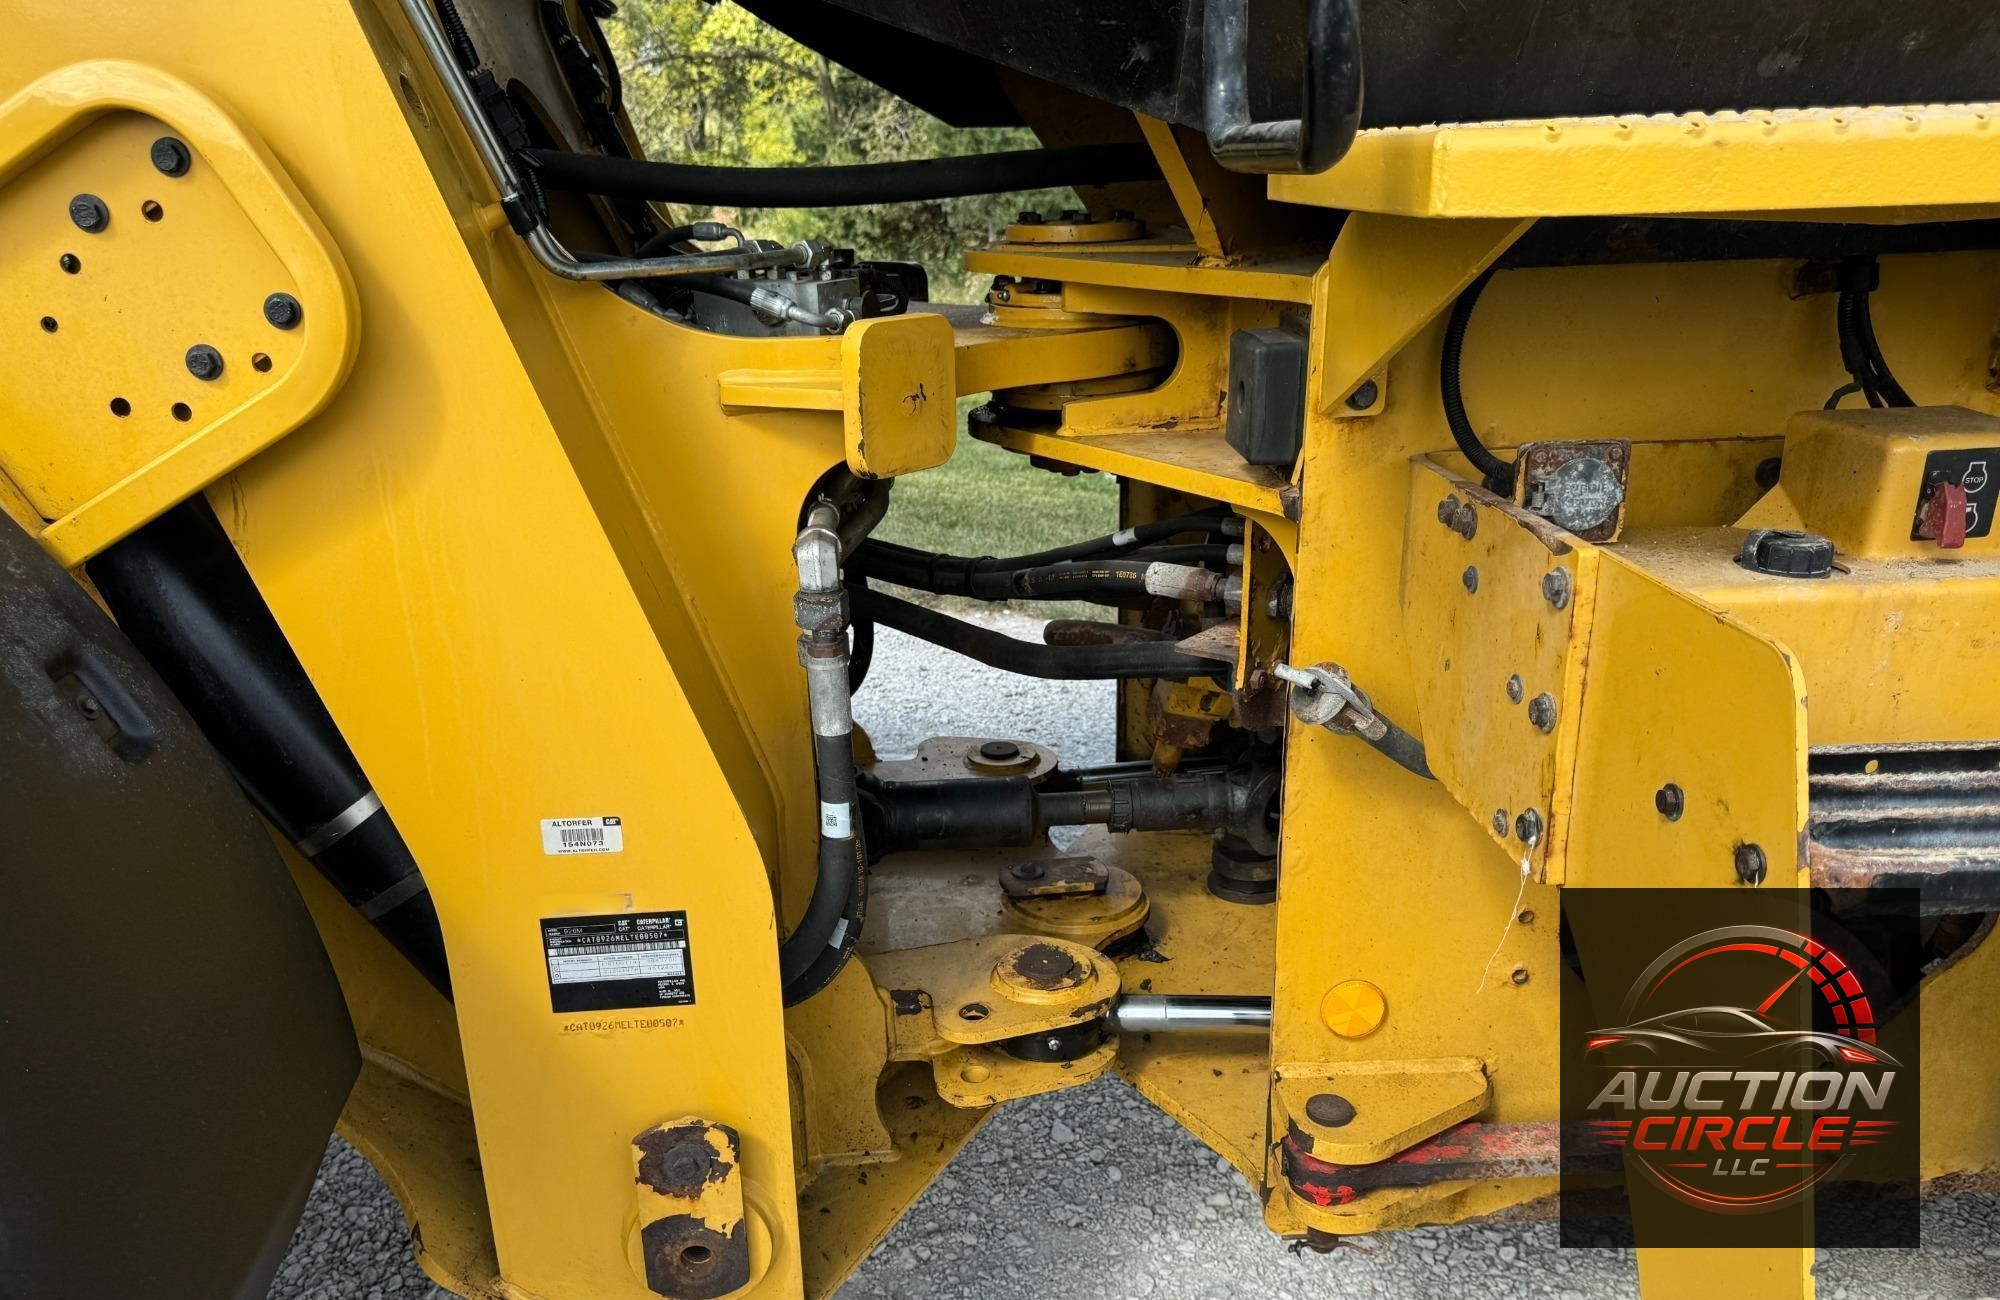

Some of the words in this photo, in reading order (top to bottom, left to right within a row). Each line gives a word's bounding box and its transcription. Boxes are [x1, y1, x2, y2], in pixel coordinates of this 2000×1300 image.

[1965, 476, 1984, 484] STOP
[551, 819, 593, 828] ALTORFER
[562, 840, 604, 848] 154N073
